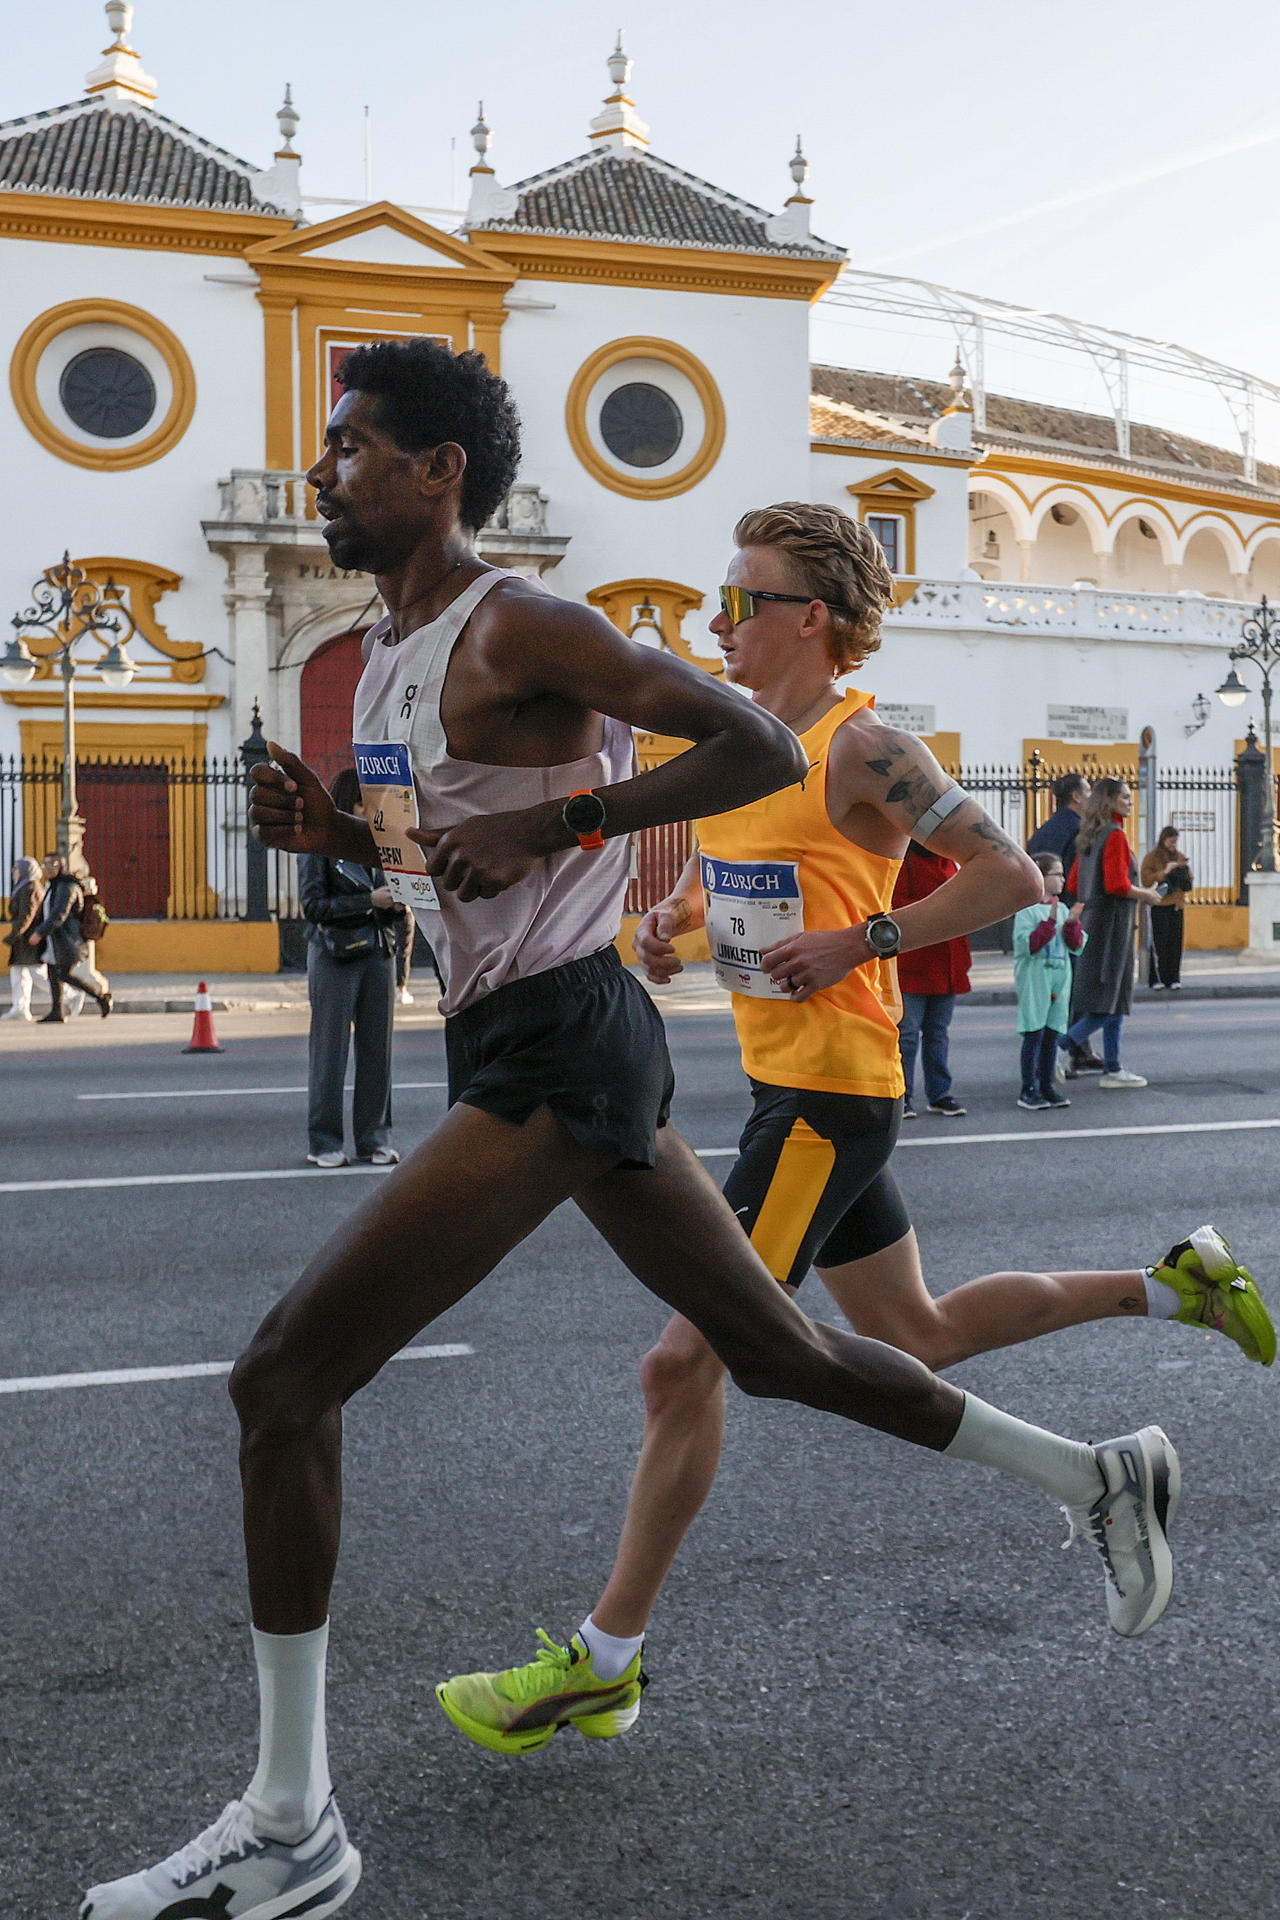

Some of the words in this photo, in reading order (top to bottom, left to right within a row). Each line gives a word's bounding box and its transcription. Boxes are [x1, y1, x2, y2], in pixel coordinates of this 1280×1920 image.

[359, 756, 401, 776] ZURICH
[721, 871, 780, 891] ZURICH
[730, 916, 745, 936] 78
